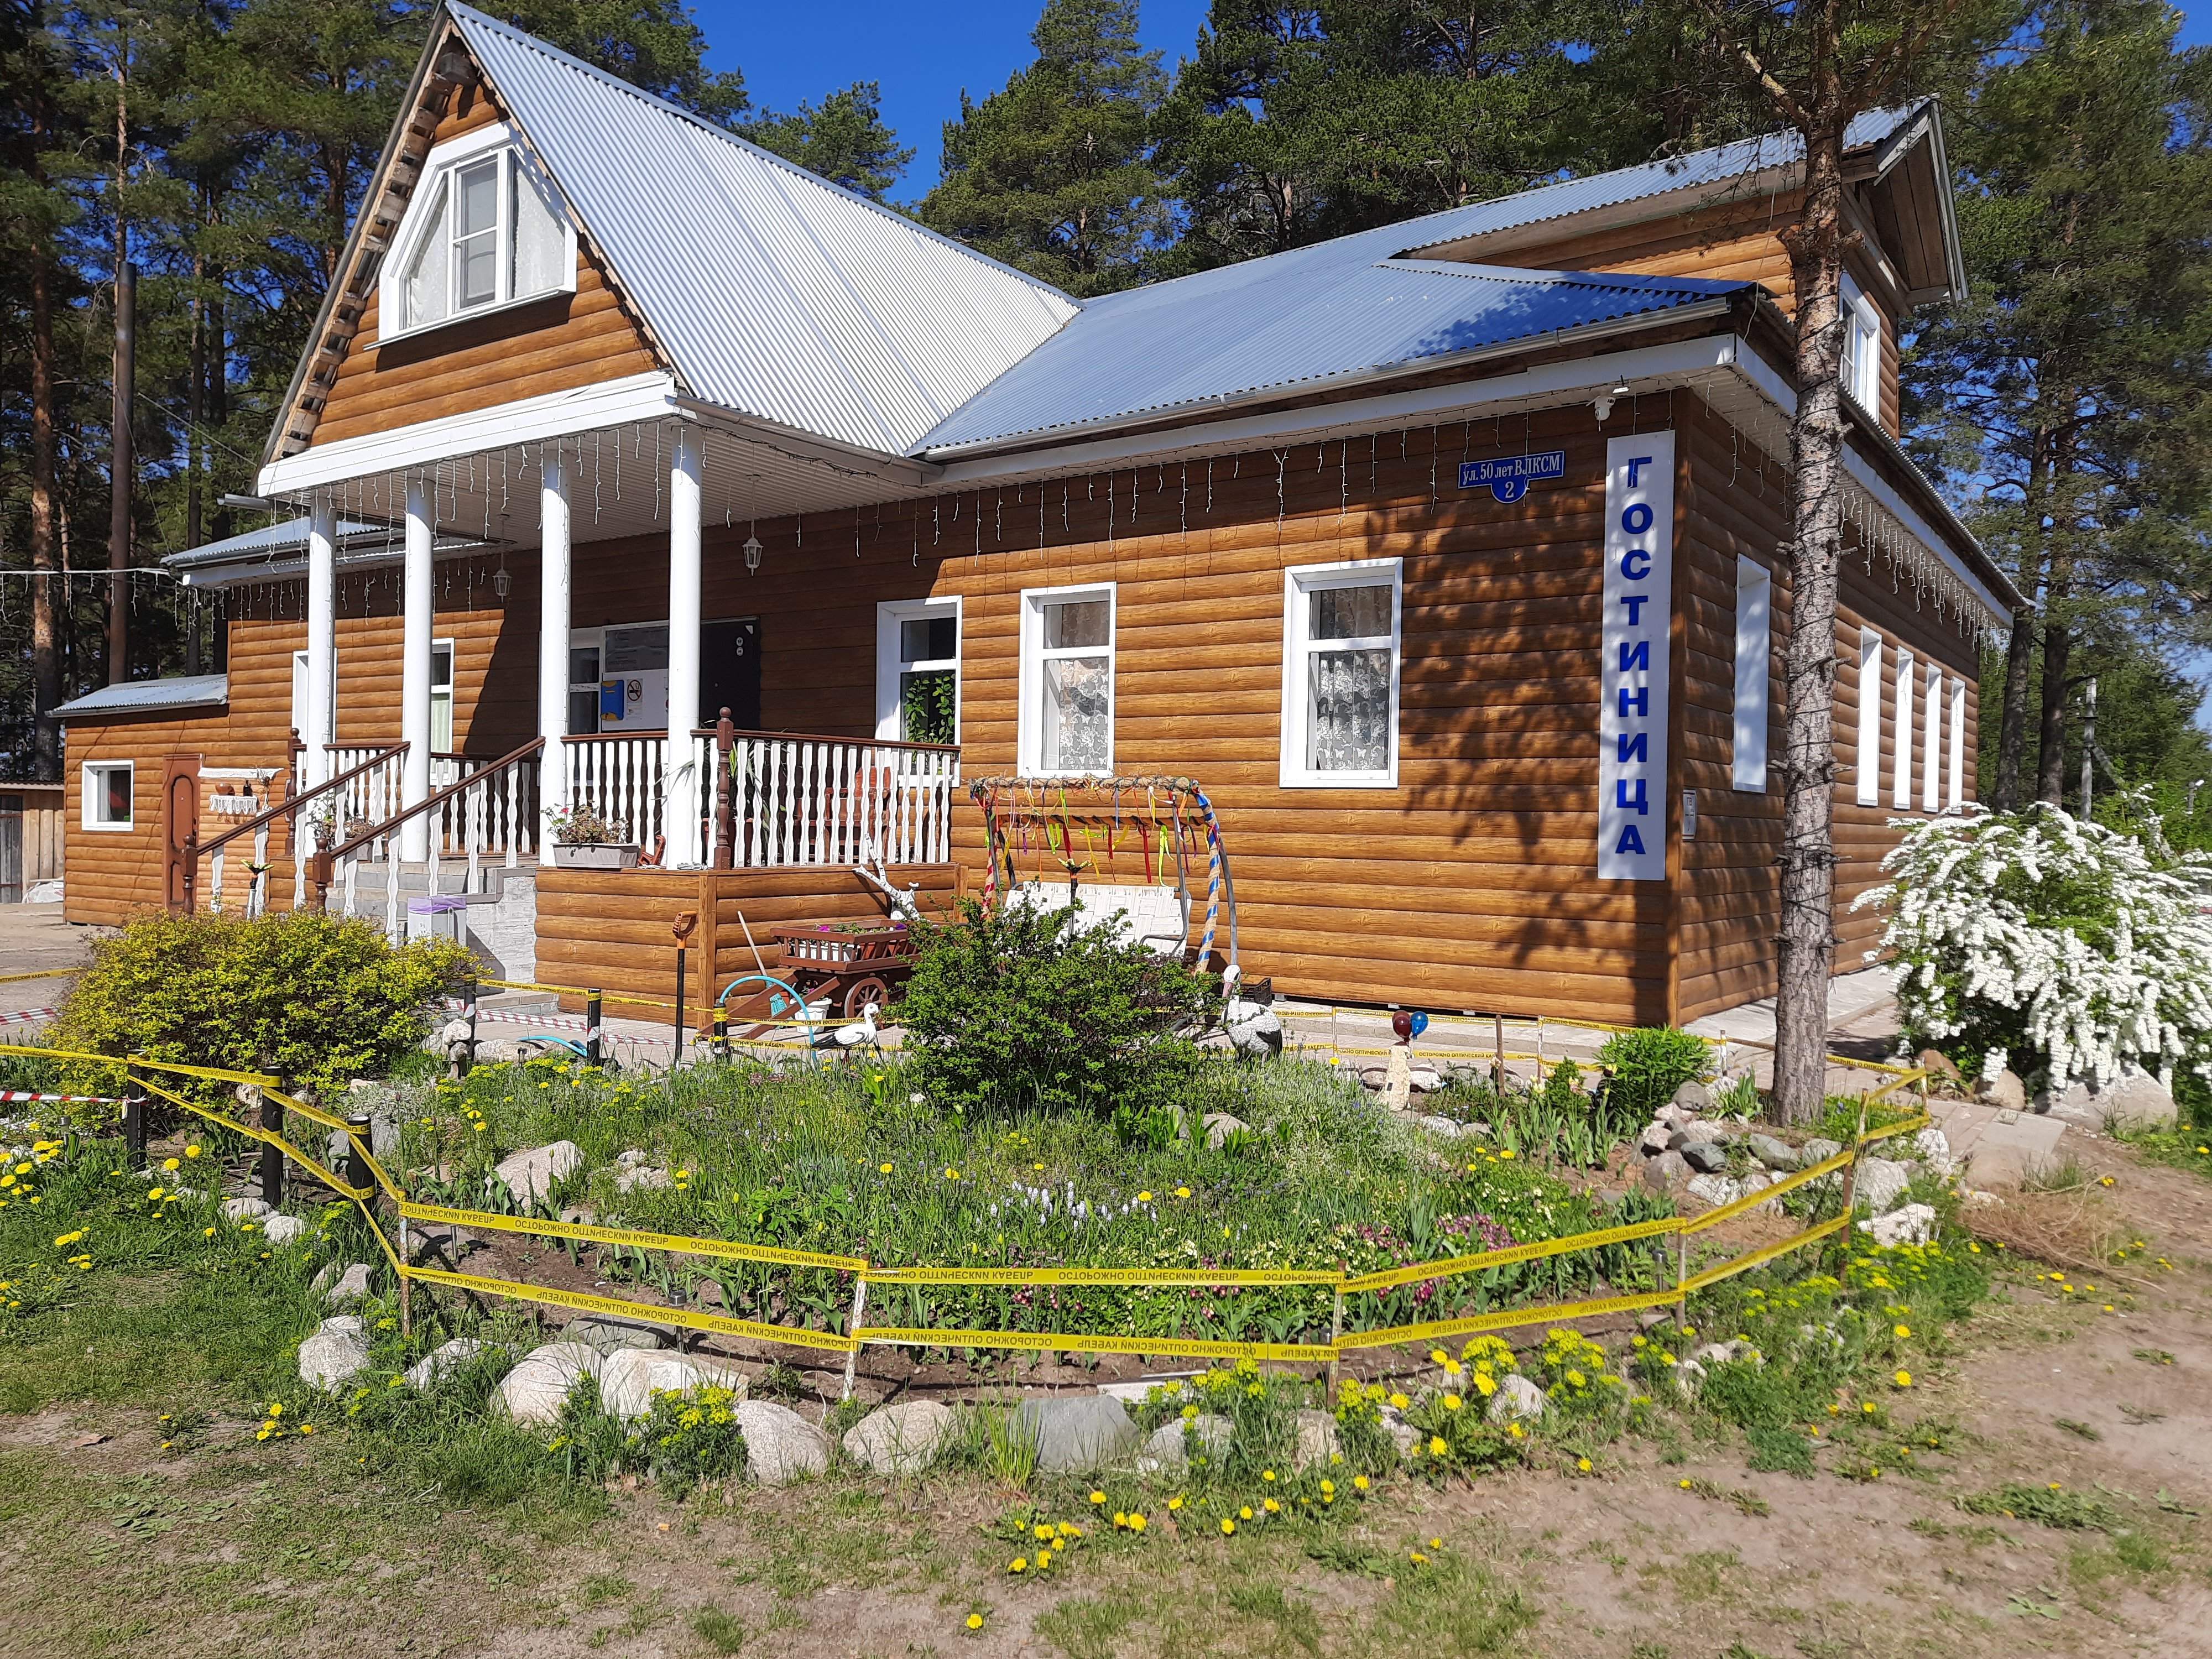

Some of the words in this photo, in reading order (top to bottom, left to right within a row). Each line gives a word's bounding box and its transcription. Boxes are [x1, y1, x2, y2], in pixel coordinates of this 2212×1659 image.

[1463, 469, 1478, 485] ул.
[1480, 463, 1493, 479] 50
[1494, 465, 1514, 478] лет
[1514, 454, 1561, 476] ВЛКСМ
[1505, 481, 1515, 498] 2
[1615, 456, 1653, 854] ГОСТИНИЦА
